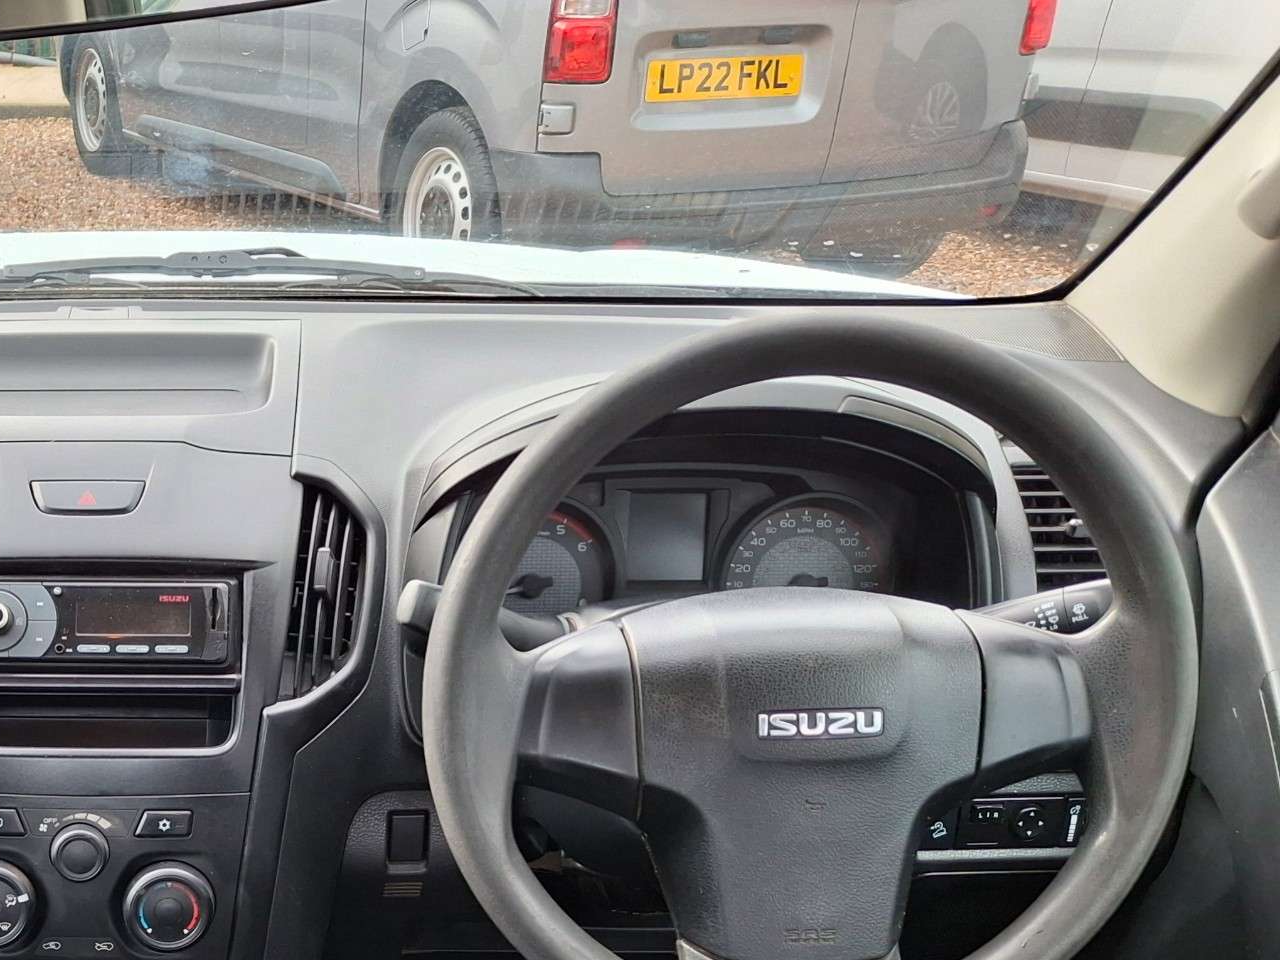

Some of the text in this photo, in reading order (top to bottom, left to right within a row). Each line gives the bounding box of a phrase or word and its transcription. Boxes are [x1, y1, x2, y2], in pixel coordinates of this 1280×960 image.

[658, 59, 789, 95] LP22 FKL
[779, 519, 796, 528] 60
[816, 519, 832, 528] 80
[556, 524, 566, 535] 5
[750, 537, 767, 546] 40
[839, 538, 859, 546] 100
[577, 542, 588, 552] 6
[734, 564, 751, 573] 20
[853, 564, 872, 573] 120
[758, 711, 881, 737] ISUZU
